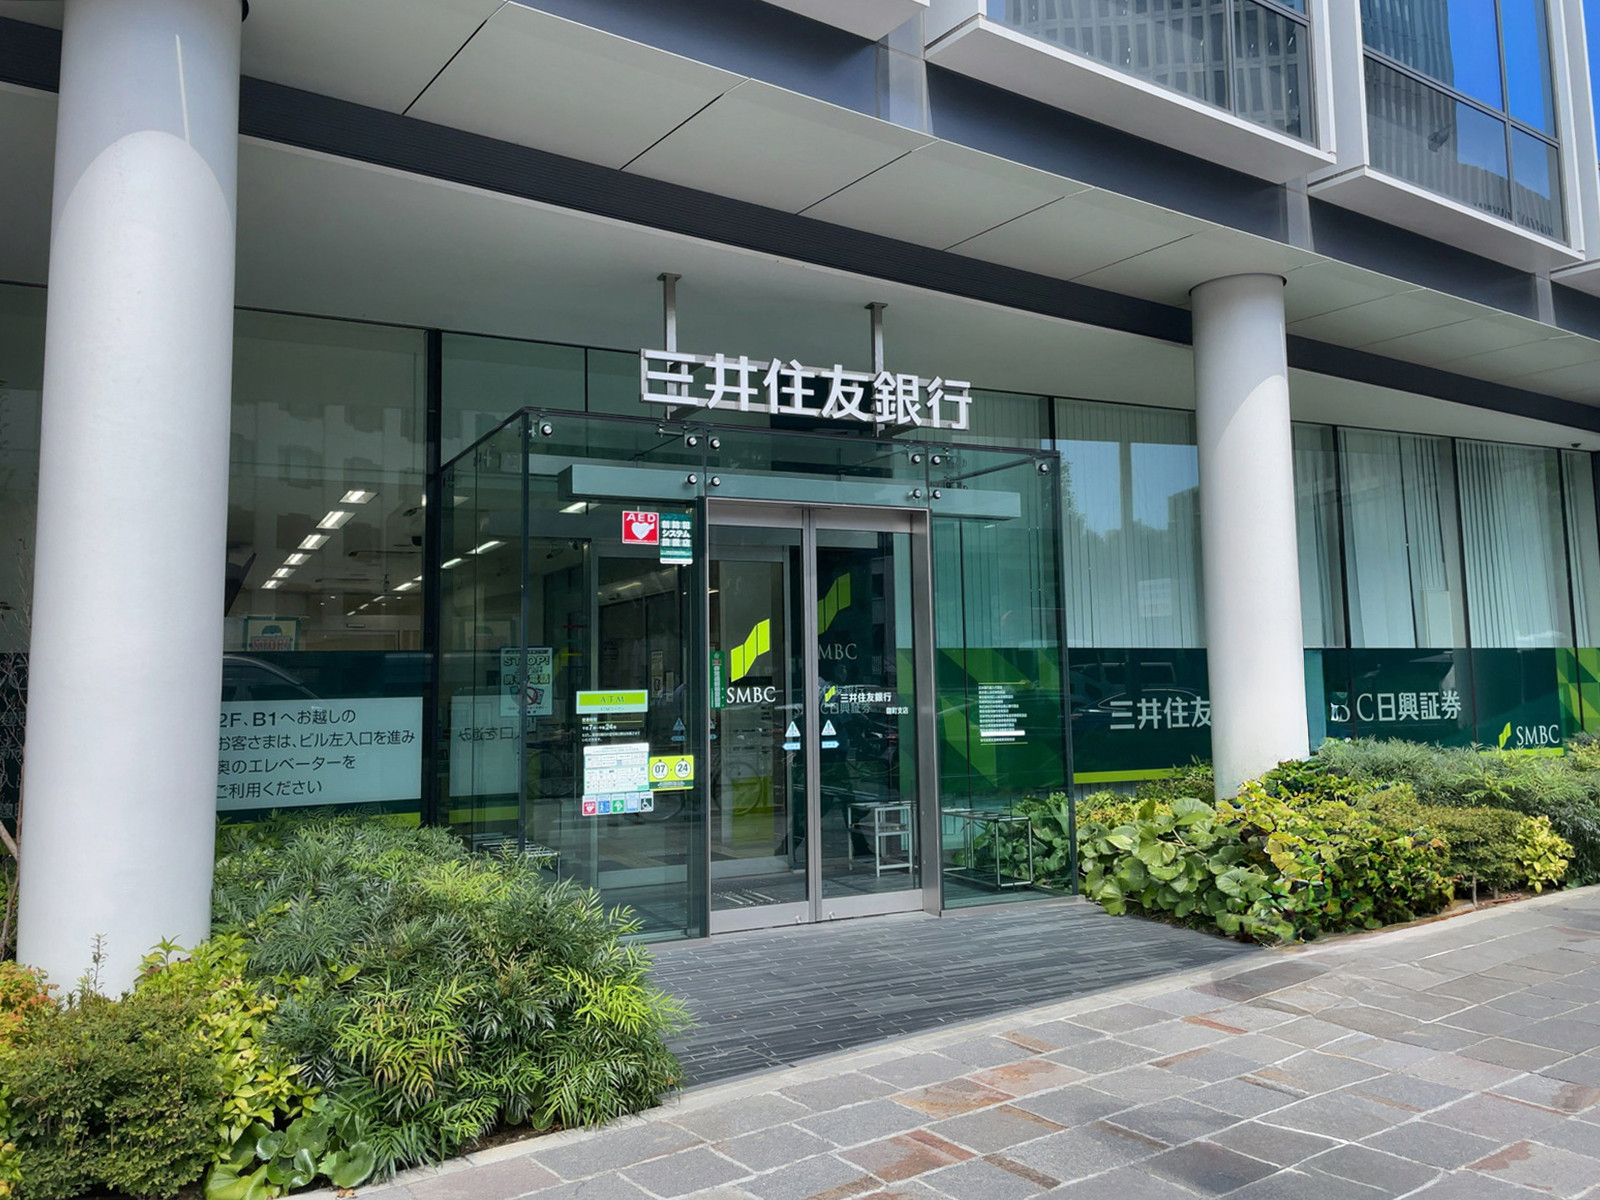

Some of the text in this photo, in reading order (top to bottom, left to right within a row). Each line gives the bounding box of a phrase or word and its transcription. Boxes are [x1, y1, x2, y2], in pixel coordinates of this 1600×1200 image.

[642, 348, 973, 430] 三井住友銀行
[626, 513, 656, 522] AED
[662, 529, 690, 538] システム
[600, 695, 625, 703] ATM
[727, 686, 776, 704] SMBC
[840, 692, 892, 703] 三井住友銀行
[220, 709, 356, 728] 2F、B1へお越しの
[1110, 696, 1211, 730] 三井住友
[219, 730, 415, 751] お客さまは、ビル左入口を進み
[1516, 724, 1560, 746] SMBC
[218, 756, 356, 775] 奥のエレベーターを
[655, 764, 665, 773] 07
[677, 763, 688, 772] 24
[217, 780, 322, 799] ご利用ください
